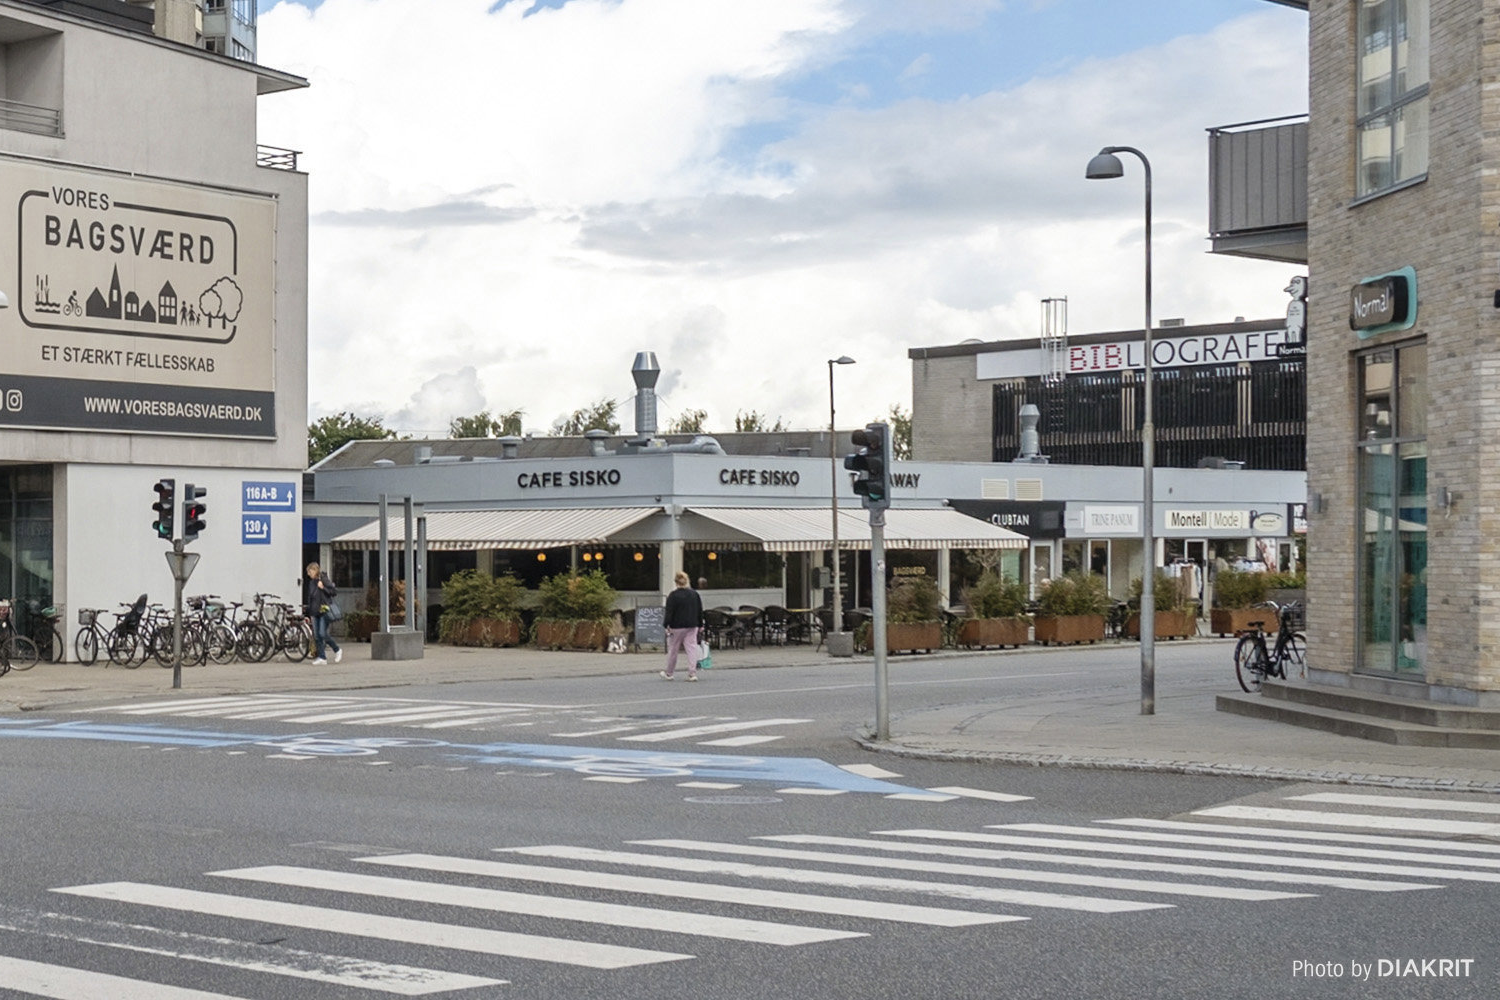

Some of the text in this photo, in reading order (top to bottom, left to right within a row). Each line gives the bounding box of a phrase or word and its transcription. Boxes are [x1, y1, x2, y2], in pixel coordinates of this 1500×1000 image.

[52, 186, 109, 211] VORES
[45, 214, 214, 265] BAGSVÆRD
[1354, 286, 1390, 319] Normal
[42, 345, 215, 373] ET STÆRKT FÆLLESSKAB
[1279, 345, 1307, 355] Norma
[84, 396, 263, 422] WWW.VORESBAGSVAERD.DK
[517, 469, 621, 489] CAFE SISKO
[719, 468, 800, 486] CAFE SISKO
[244, 520, 261, 533] 130
[991, 513, 1030, 527] CLUBTAN
[1171, 511, 1207, 527] Montell
